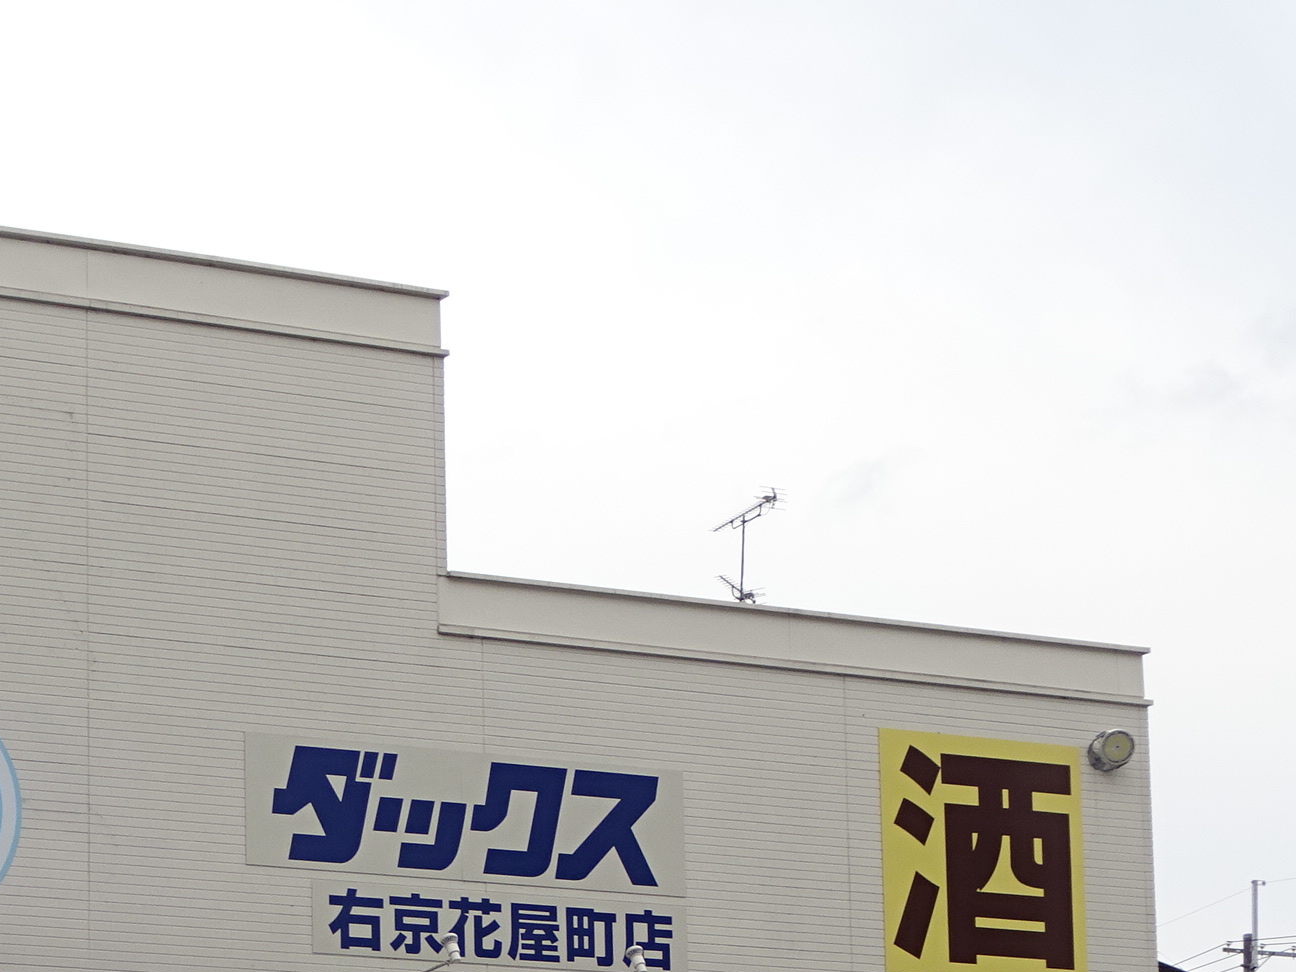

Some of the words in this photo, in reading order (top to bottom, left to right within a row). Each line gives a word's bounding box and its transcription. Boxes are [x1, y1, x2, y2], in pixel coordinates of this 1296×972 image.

[271, 745, 659, 887] ダックス
[893, 745, 1075, 970] 酒
[328, 888, 673, 971] 右京花屋町店
